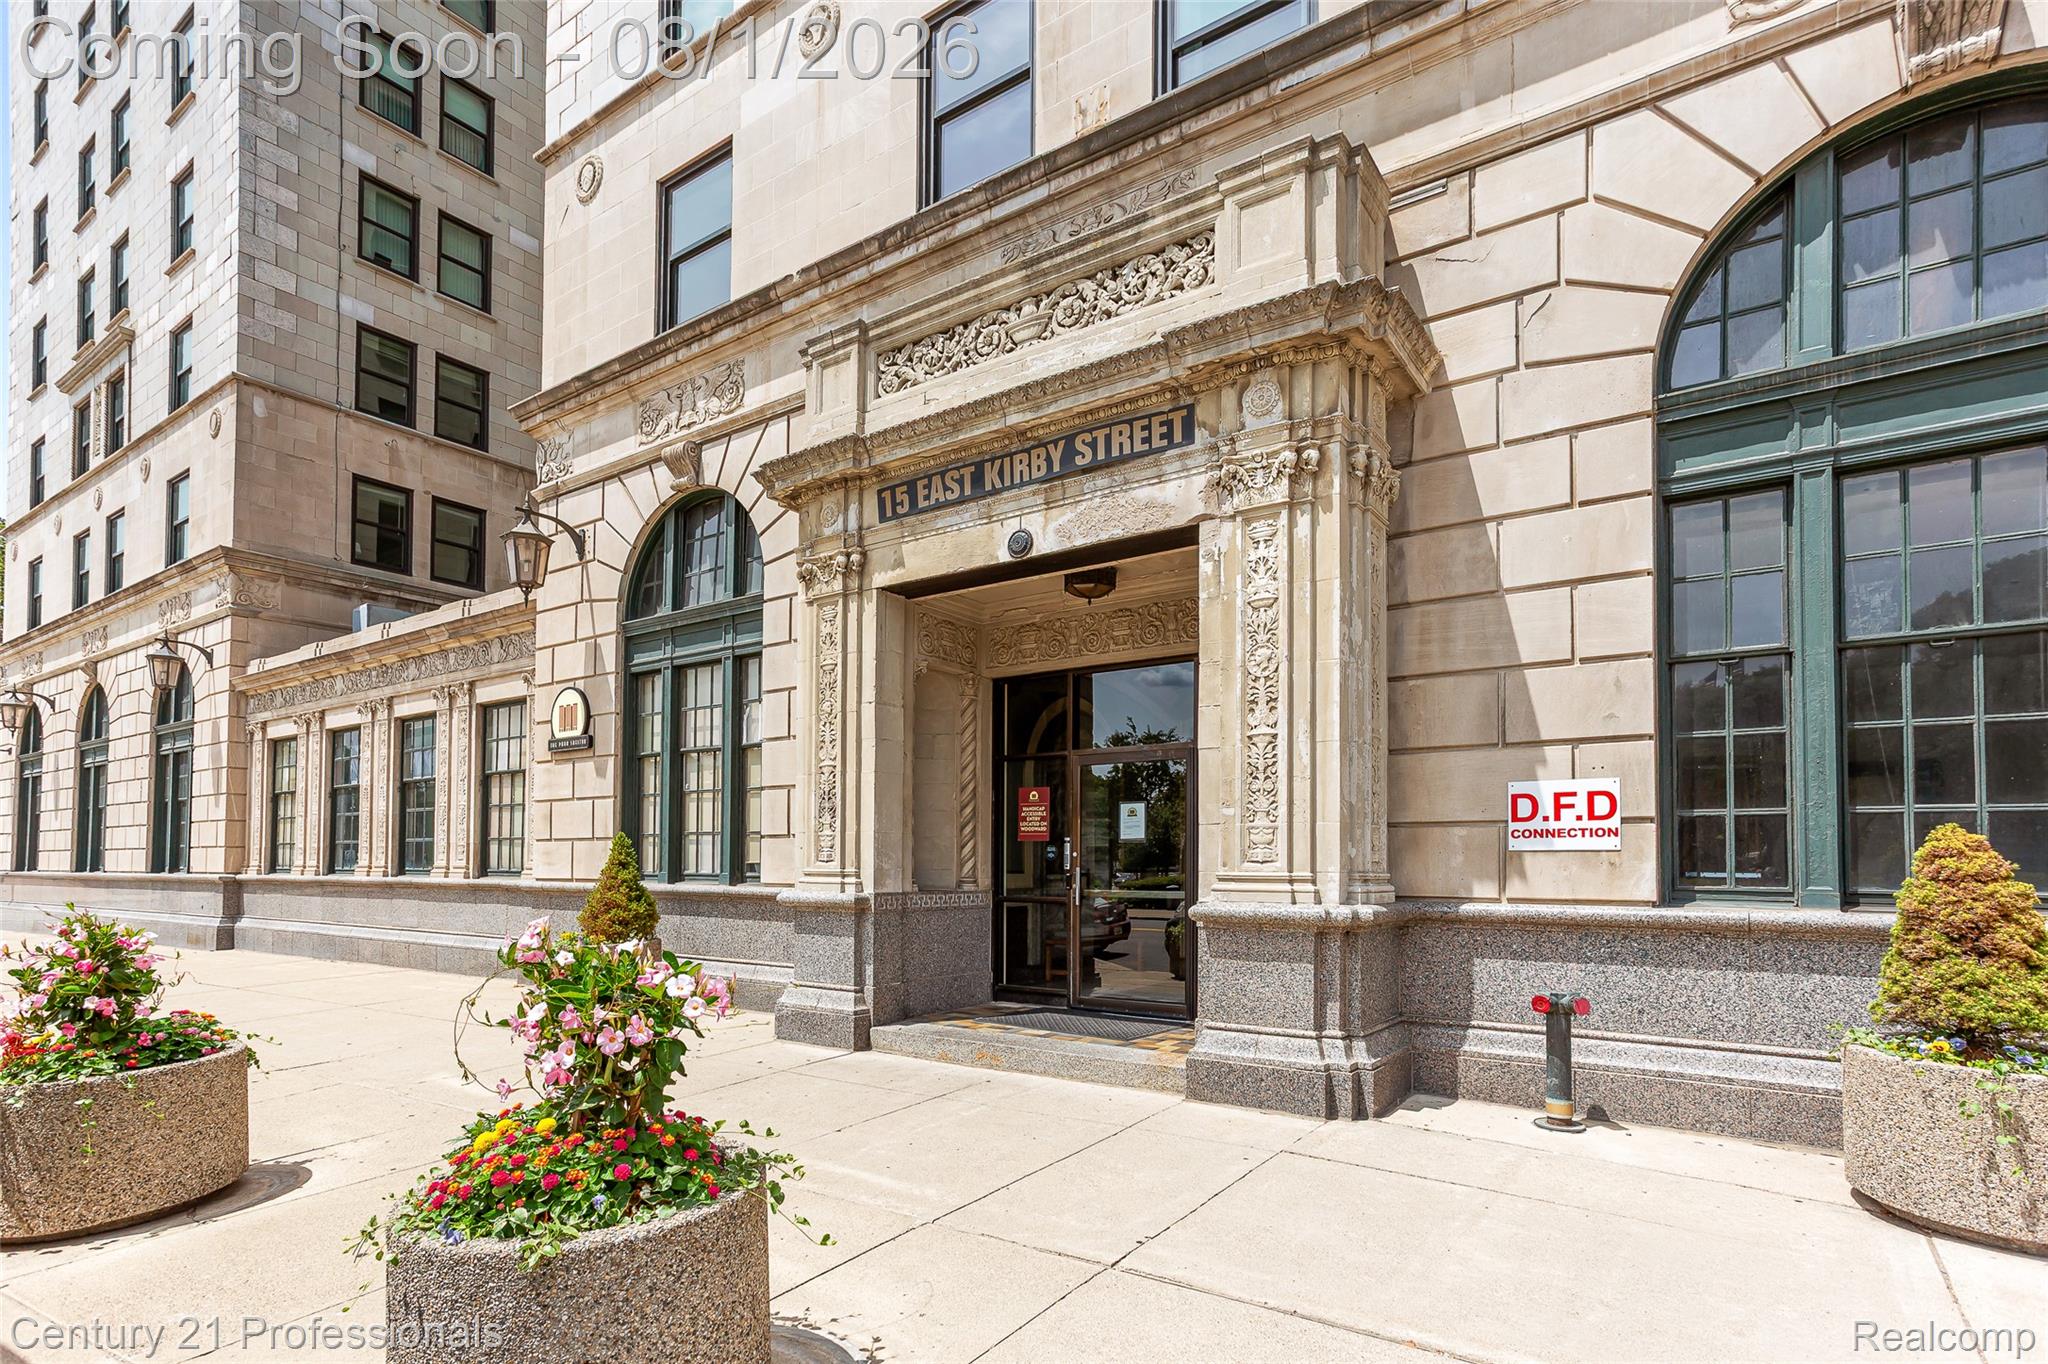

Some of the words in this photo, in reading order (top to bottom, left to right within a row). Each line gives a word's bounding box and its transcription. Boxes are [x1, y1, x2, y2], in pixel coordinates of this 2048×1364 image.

[881, 485, 910, 518] 15
[917, 466, 975, 509] EAST
[984, 440, 1066, 491] KIRBY
[1074, 409, 1188, 466] STREET
[1510, 790, 1617, 822] D.F.D
[1510, 827, 1619, 839] CONNECTION
